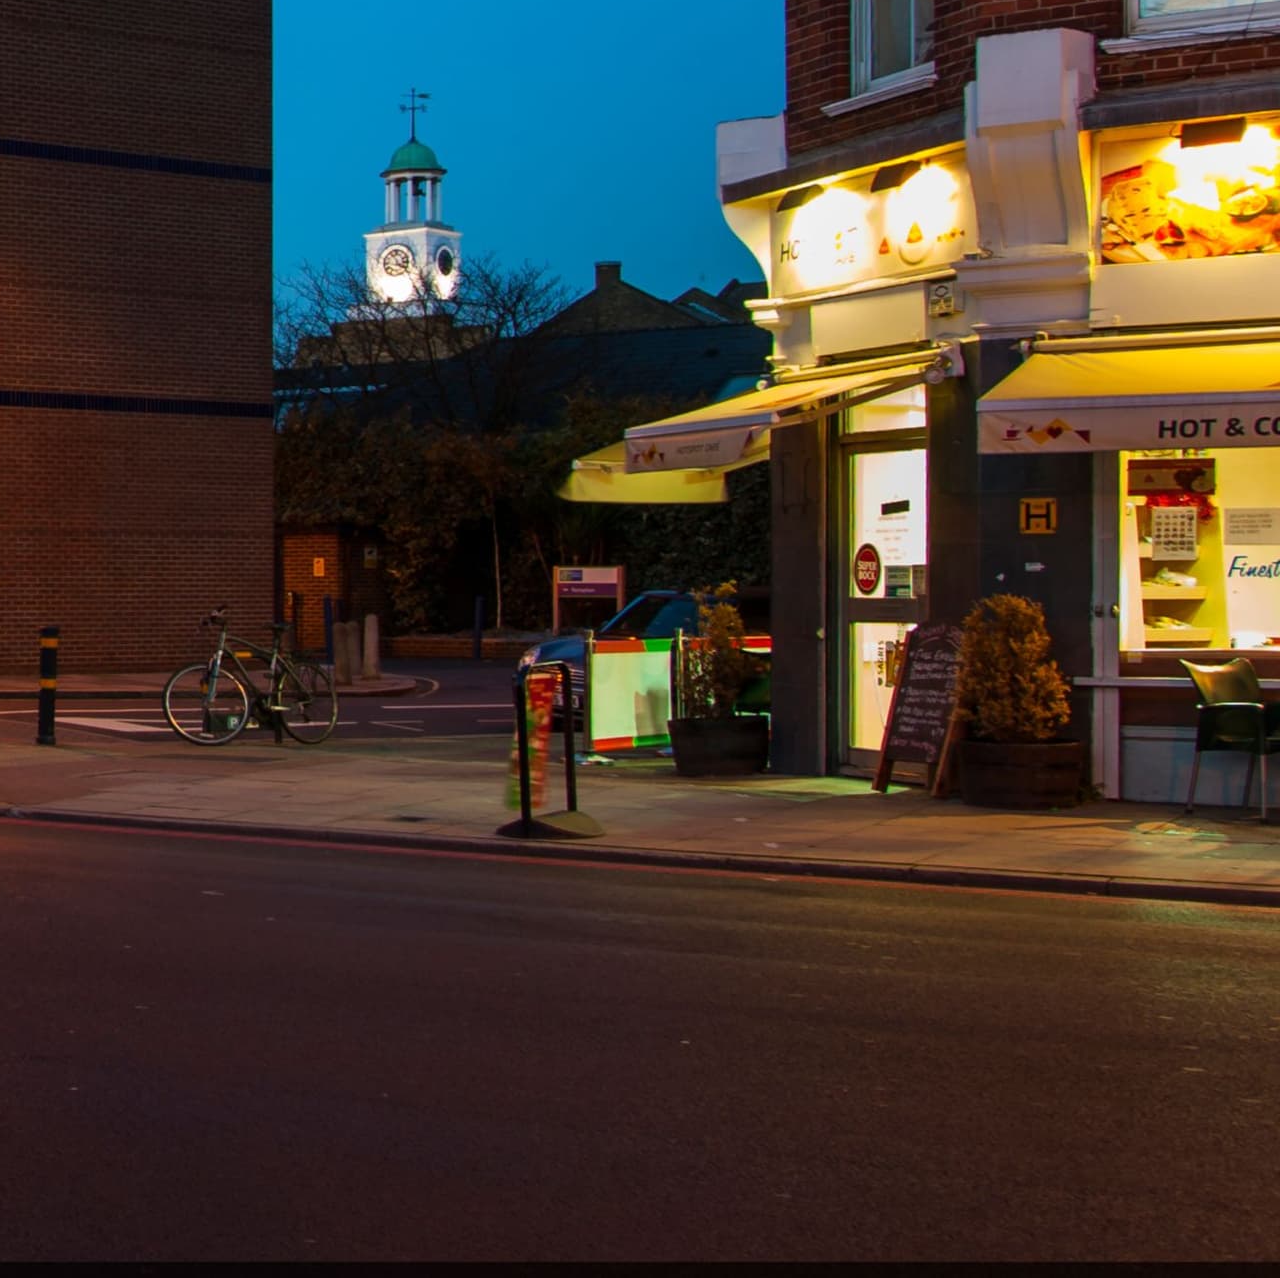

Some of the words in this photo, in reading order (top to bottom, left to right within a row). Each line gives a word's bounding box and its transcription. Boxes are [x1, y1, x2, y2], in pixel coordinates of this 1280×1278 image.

[1158, 419, 1217, 439] HOT
[1225, 417, 1245, 437] &
[1025, 502, 1051, 530] H
[857, 561, 877, 570] SUPER
[1228, 555, 1280, 579] Finest
